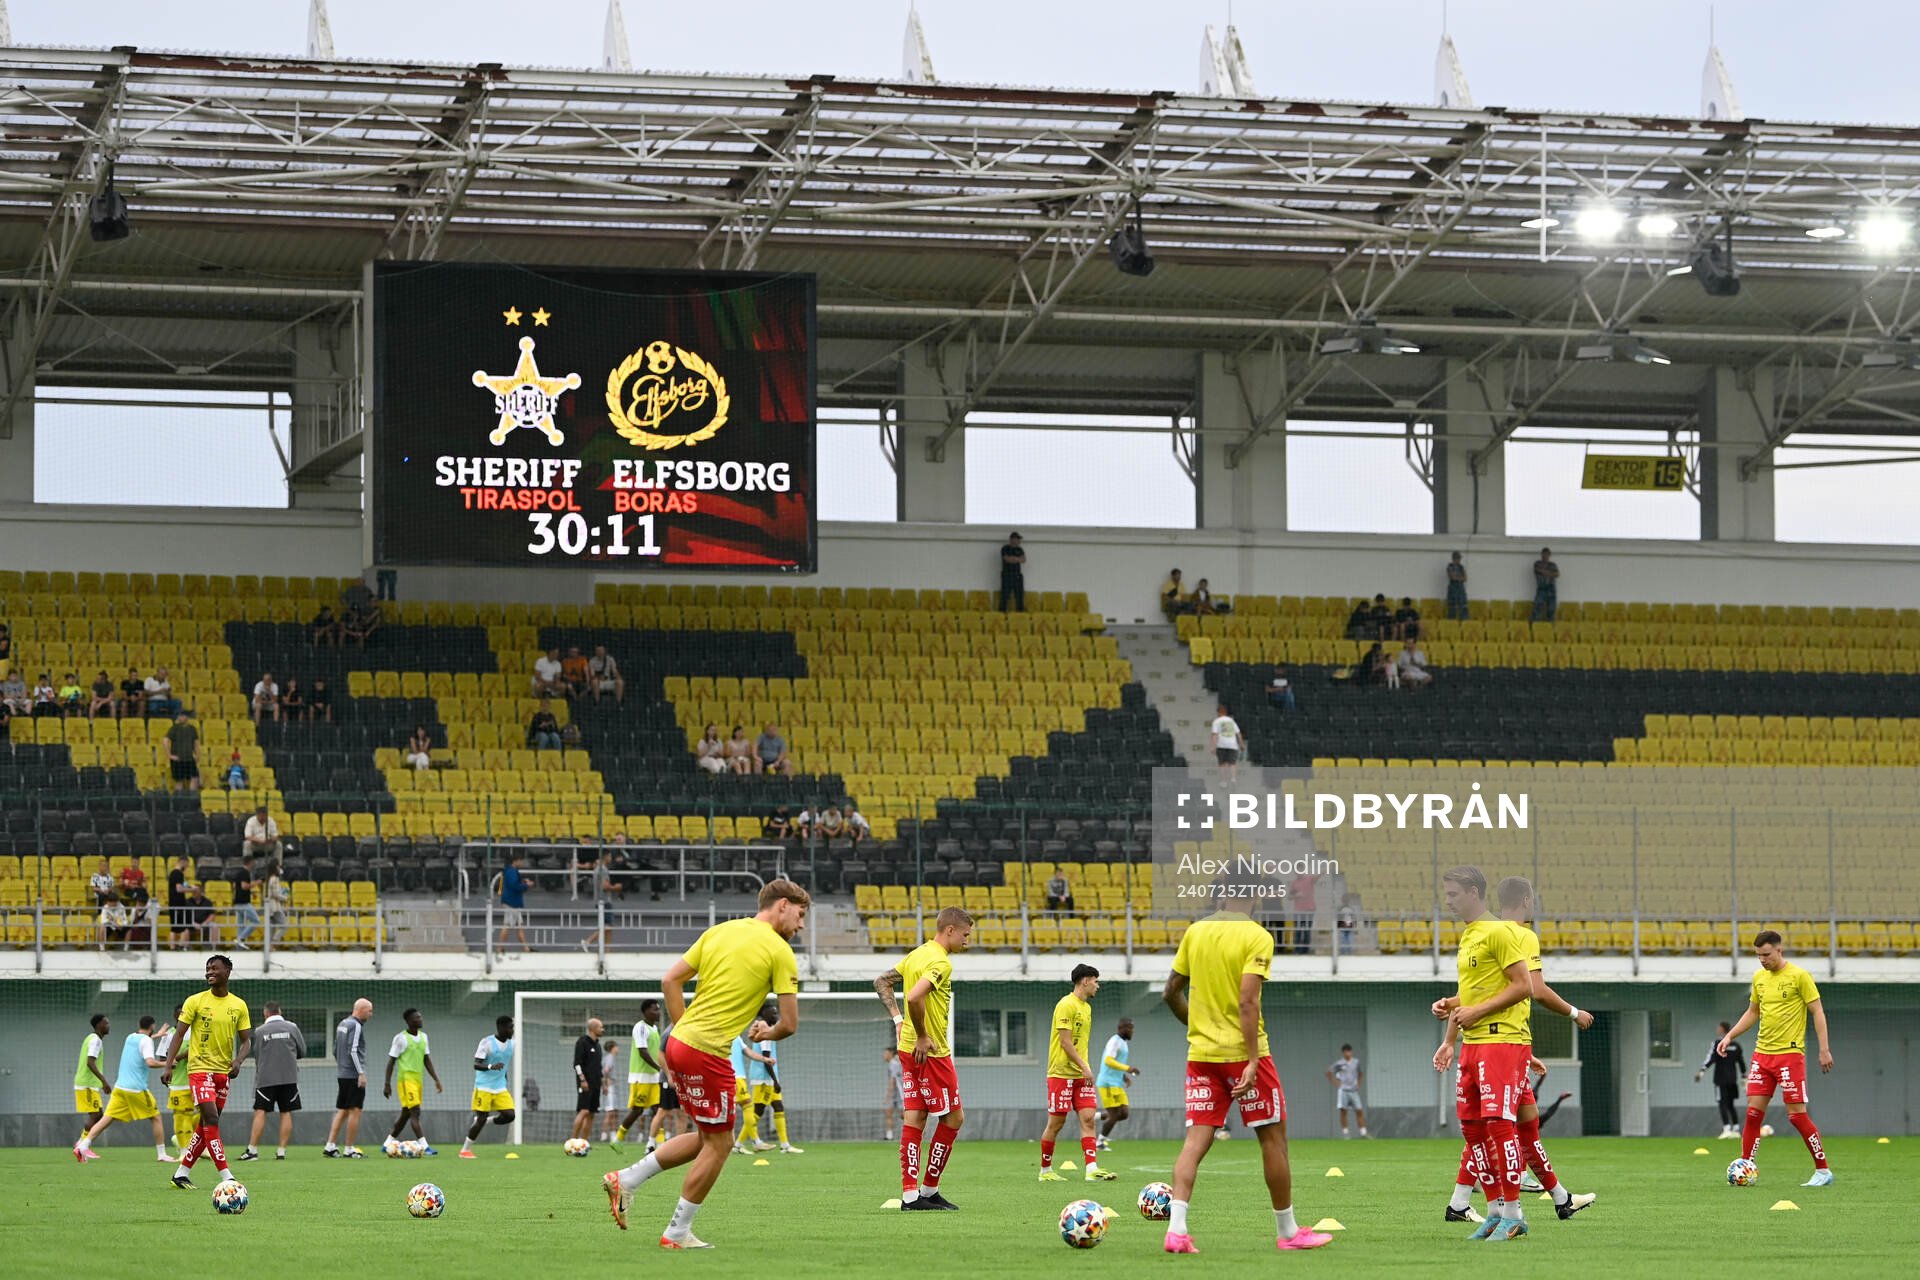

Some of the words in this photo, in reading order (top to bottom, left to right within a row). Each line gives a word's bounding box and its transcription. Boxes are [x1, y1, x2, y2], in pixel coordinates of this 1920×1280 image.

[495, 392, 560, 415] SHERIFF
[435, 456, 582, 488] SHERIFF
[613, 460, 790, 492] ELFSBORG
[1593, 472, 1646, 486] SECTOR
[1656, 464, 1680, 485] 15
[460, 488, 581, 512] TIRASPOL
[615, 492, 697, 514] BORAS
[527, 512, 661, 556] 30:11
[1468, 956, 1477, 968] 15
[200, 1091, 210, 1100] 14
